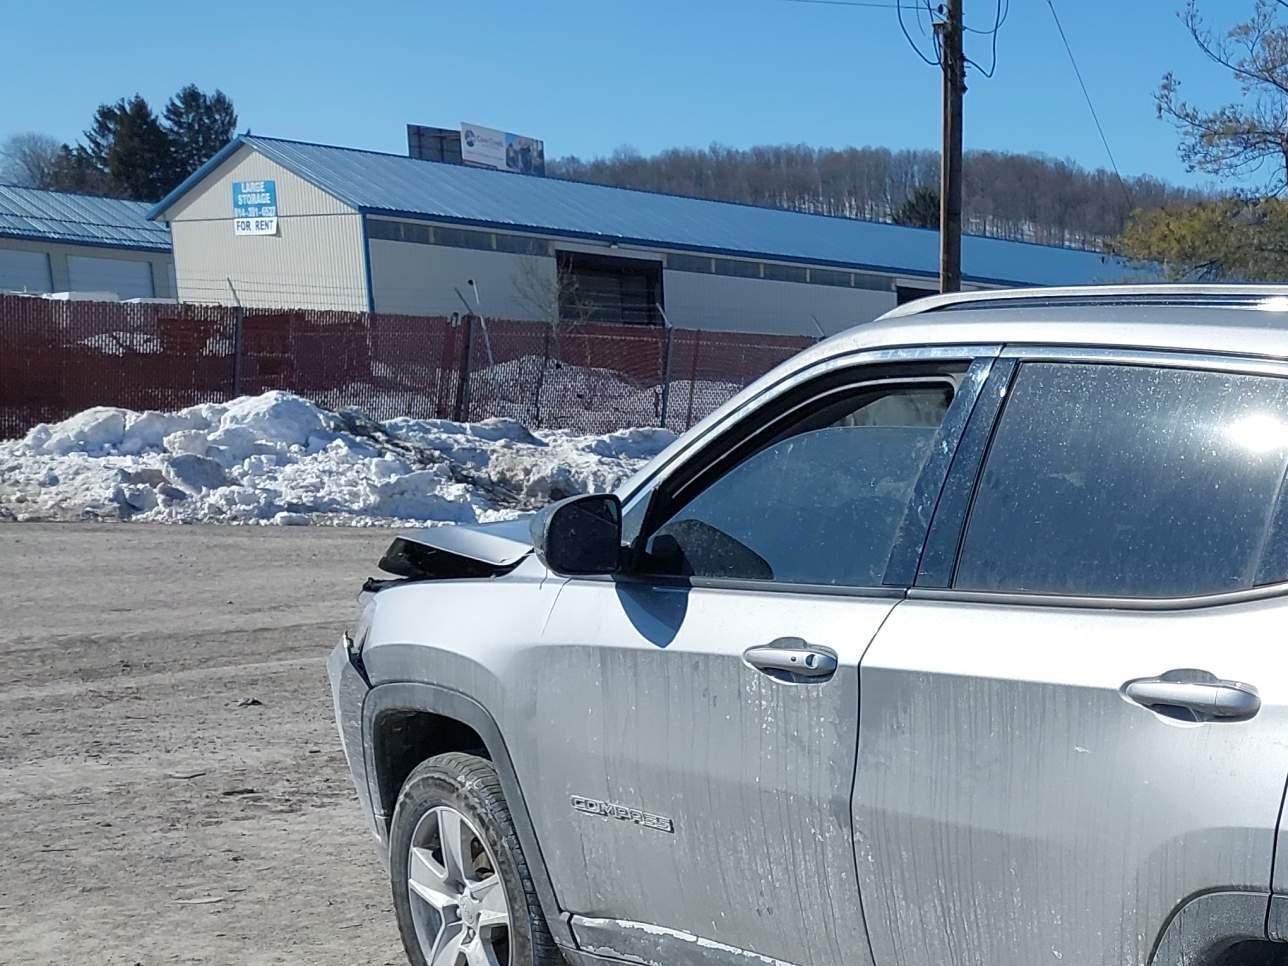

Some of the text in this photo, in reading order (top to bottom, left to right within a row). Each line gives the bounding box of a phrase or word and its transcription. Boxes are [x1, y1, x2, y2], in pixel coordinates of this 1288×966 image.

[238, 193, 271, 205] STORAGE
[236, 220, 274, 231] FOR RENT
